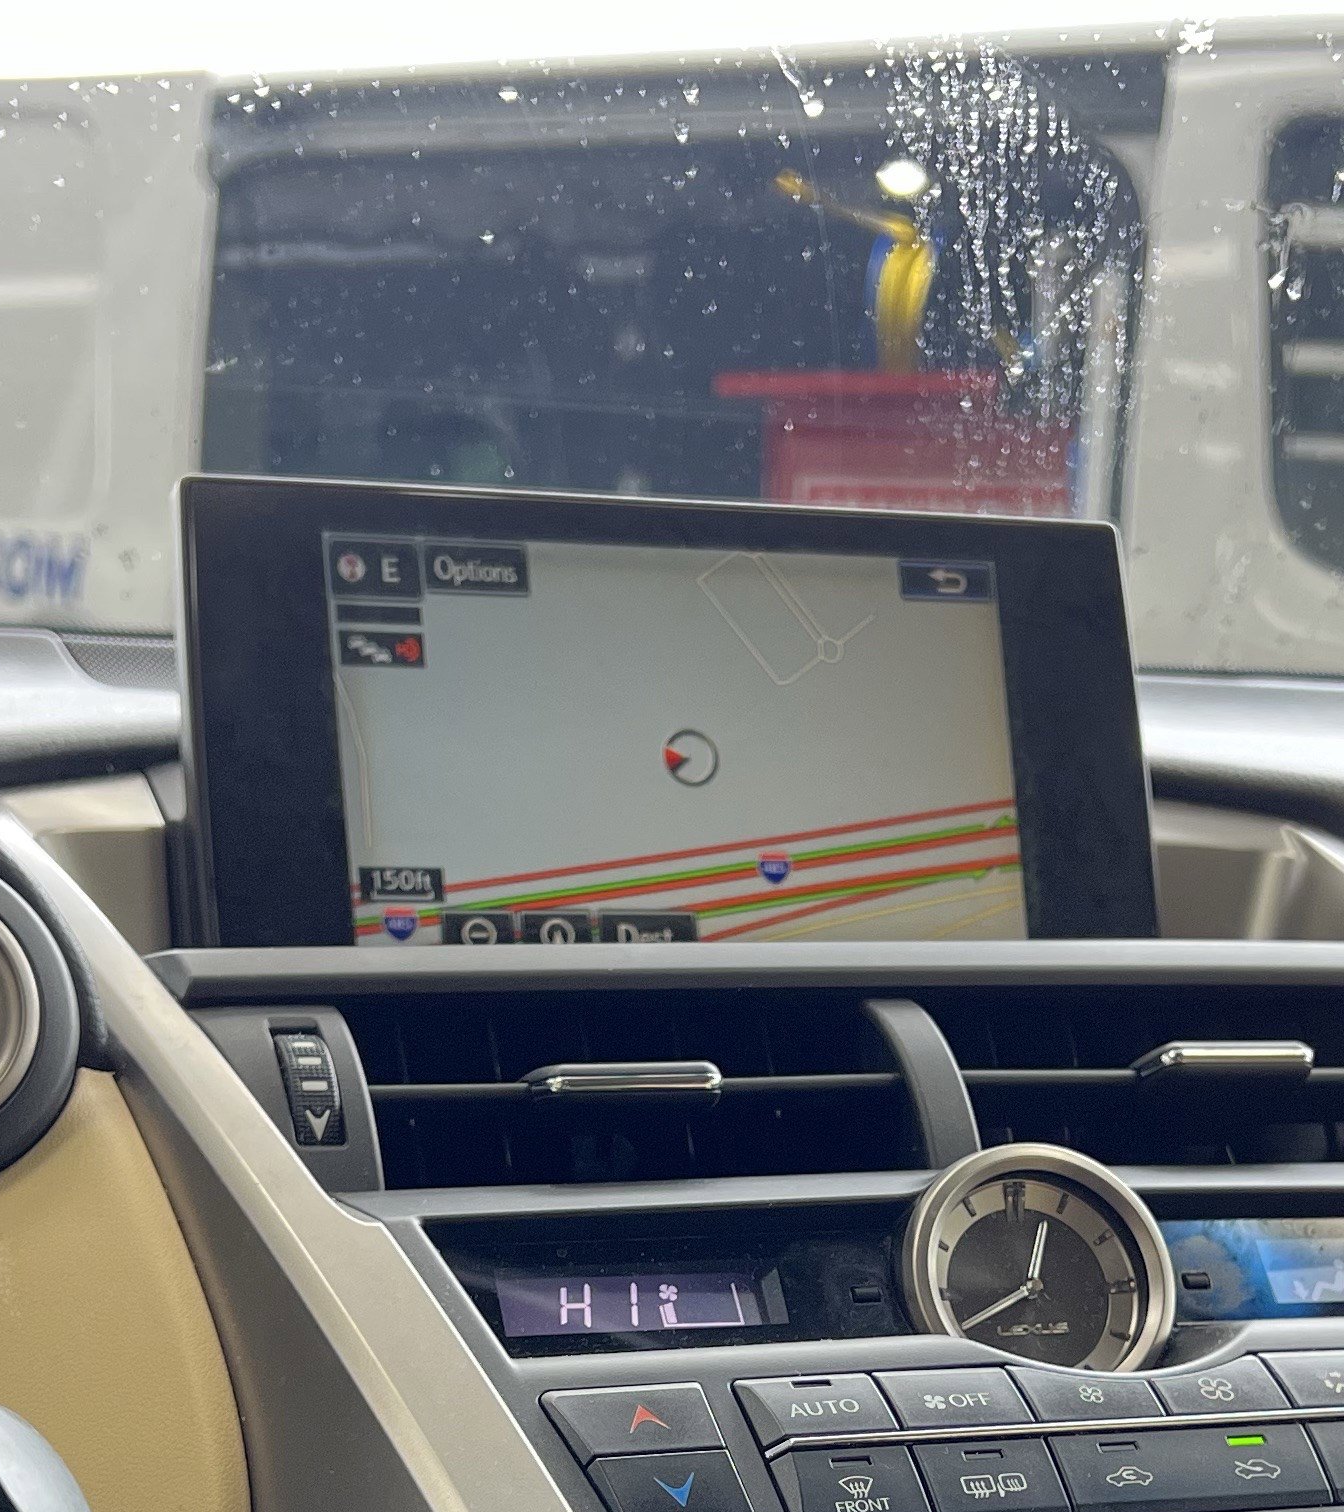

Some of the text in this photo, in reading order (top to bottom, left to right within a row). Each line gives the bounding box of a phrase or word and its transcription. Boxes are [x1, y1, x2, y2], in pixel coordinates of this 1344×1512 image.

[380, 554, 518, 586] E Options
[371, 869, 433, 893] 150ft
[789, 1398, 861, 1418] AUTO
[948, 1391, 991, 1408] OFF
